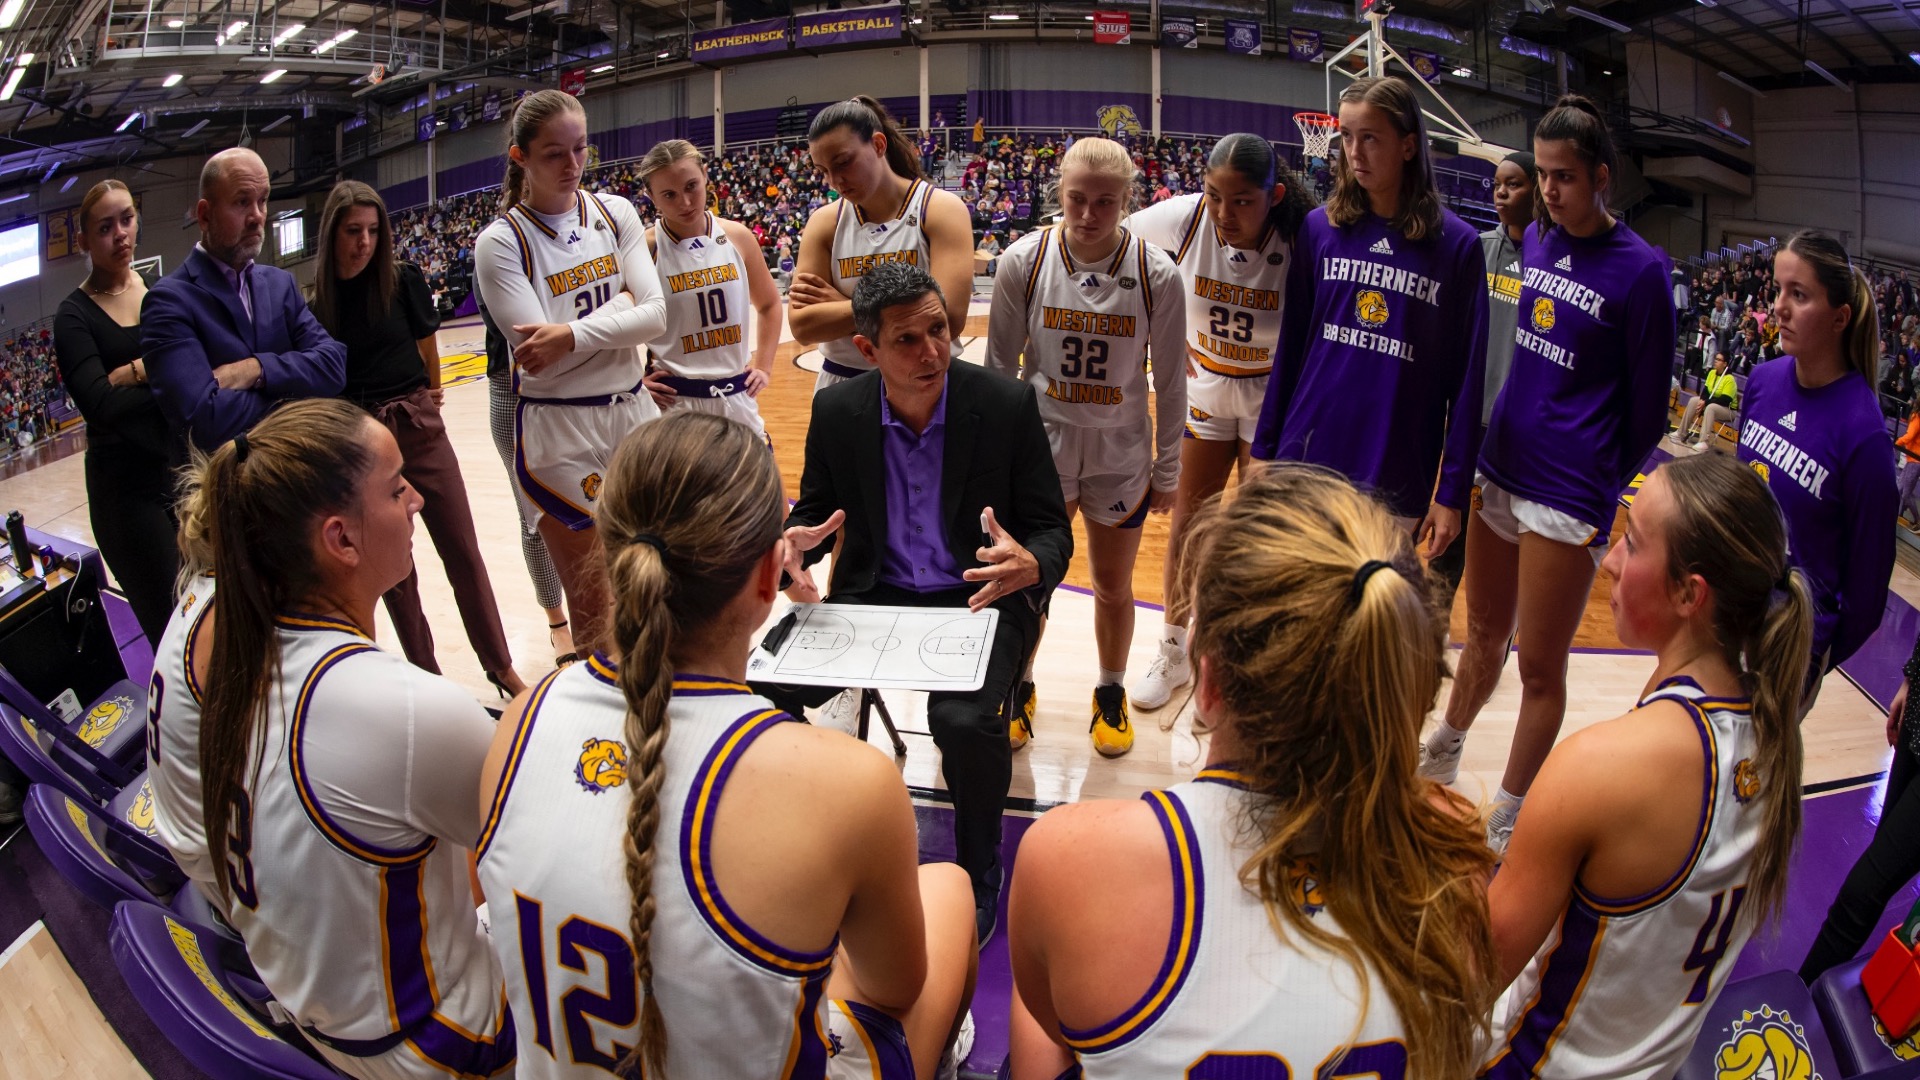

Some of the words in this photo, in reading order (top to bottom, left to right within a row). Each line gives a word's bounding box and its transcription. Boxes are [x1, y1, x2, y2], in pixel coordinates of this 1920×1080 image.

[695, 30, 784, 51] LEATHERNECK
[802, 17, 894, 37] BASKETBALL
[1097, 23, 1127, 34] SIUE
[1482, 178, 1491, 189] G
[1369, 246, 1394, 256] adidas
[1554, 261, 1573, 272] adidas
[1194, 274, 1279, 311] WESTERN
[1323, 257, 1441, 306] LEATHERNECK
[696, 287, 729, 327] 10
[1042, 305, 1137, 337] WESTERN
[1209, 305, 1255, 343] 23
[681, 323, 742, 354] ILLINOI
[1322, 322, 1415, 362] BASKETBALL
[1061, 336, 1109, 380] 32
[1740, 418, 1829, 500] EATHERNECK
[512, 887, 647, 1080] 12
